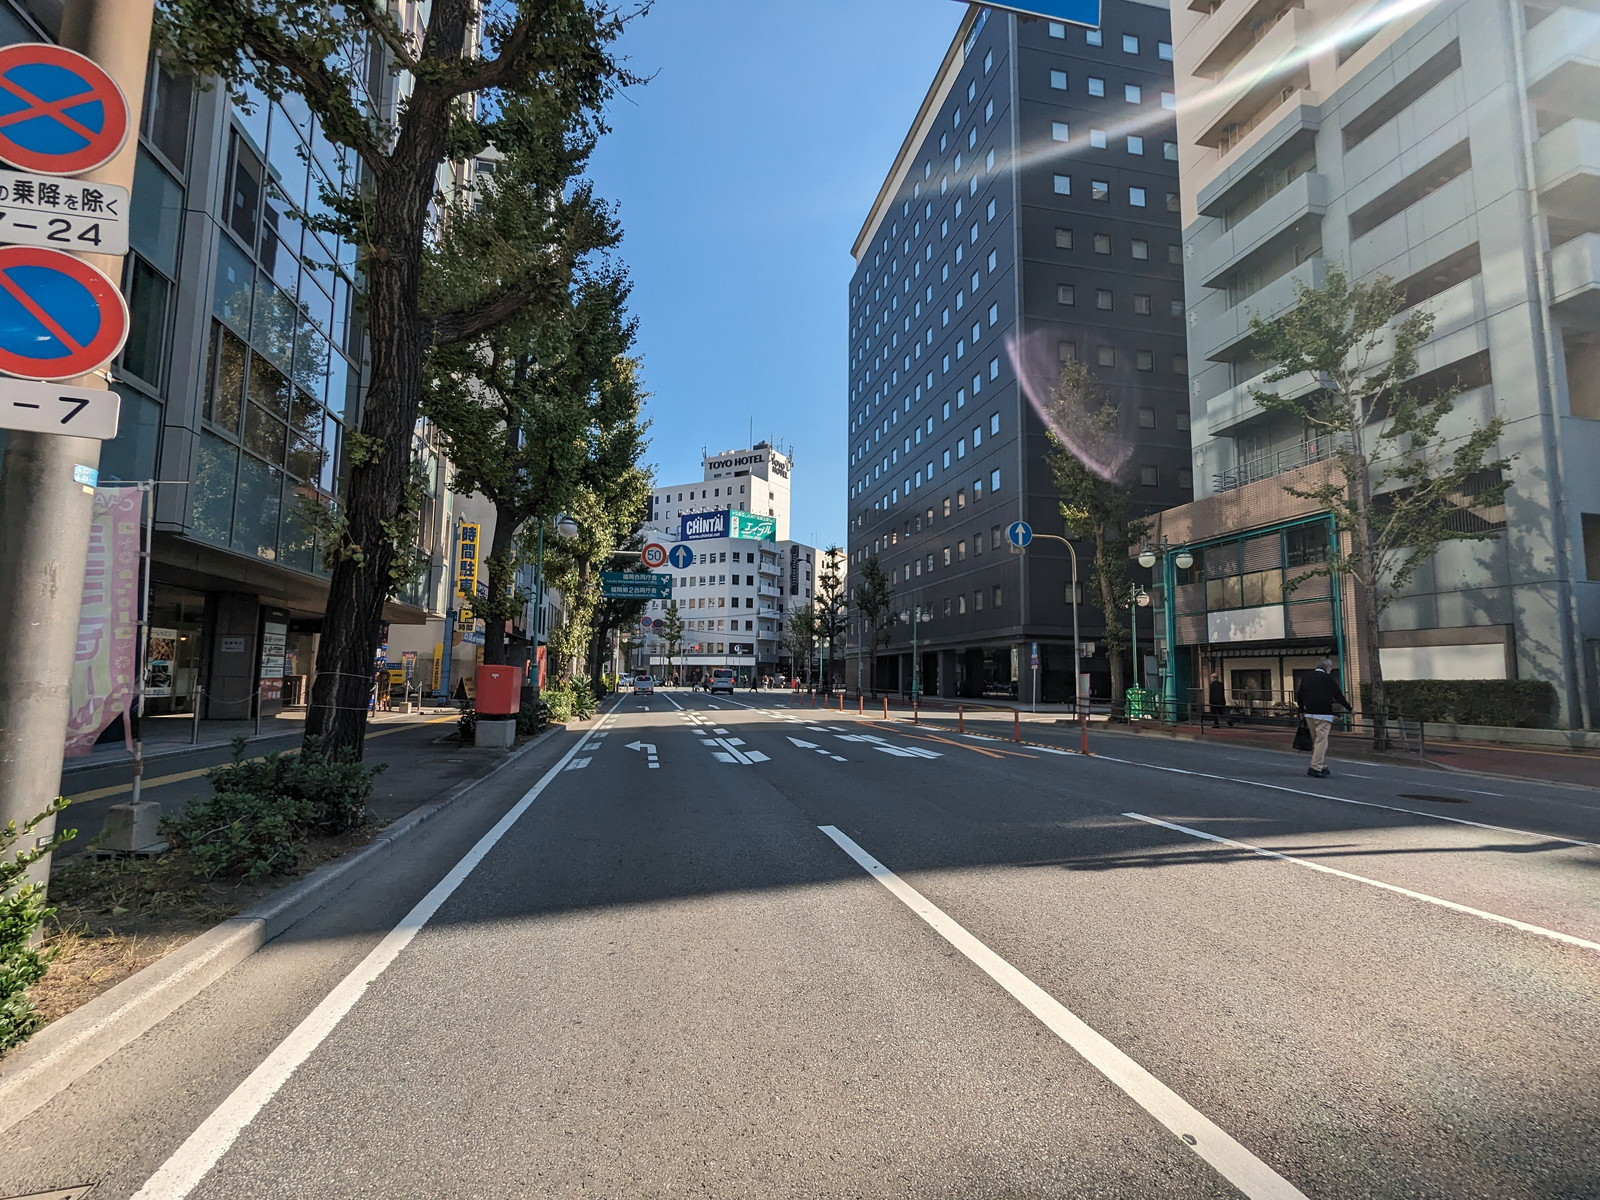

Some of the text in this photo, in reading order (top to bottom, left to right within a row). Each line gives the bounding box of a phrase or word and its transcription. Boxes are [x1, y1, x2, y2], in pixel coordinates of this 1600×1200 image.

[0, 212, 102, 246] -24
[708, 455, 765, 470] TOYO HOTEL
[647, 550, 661, 561] 50
